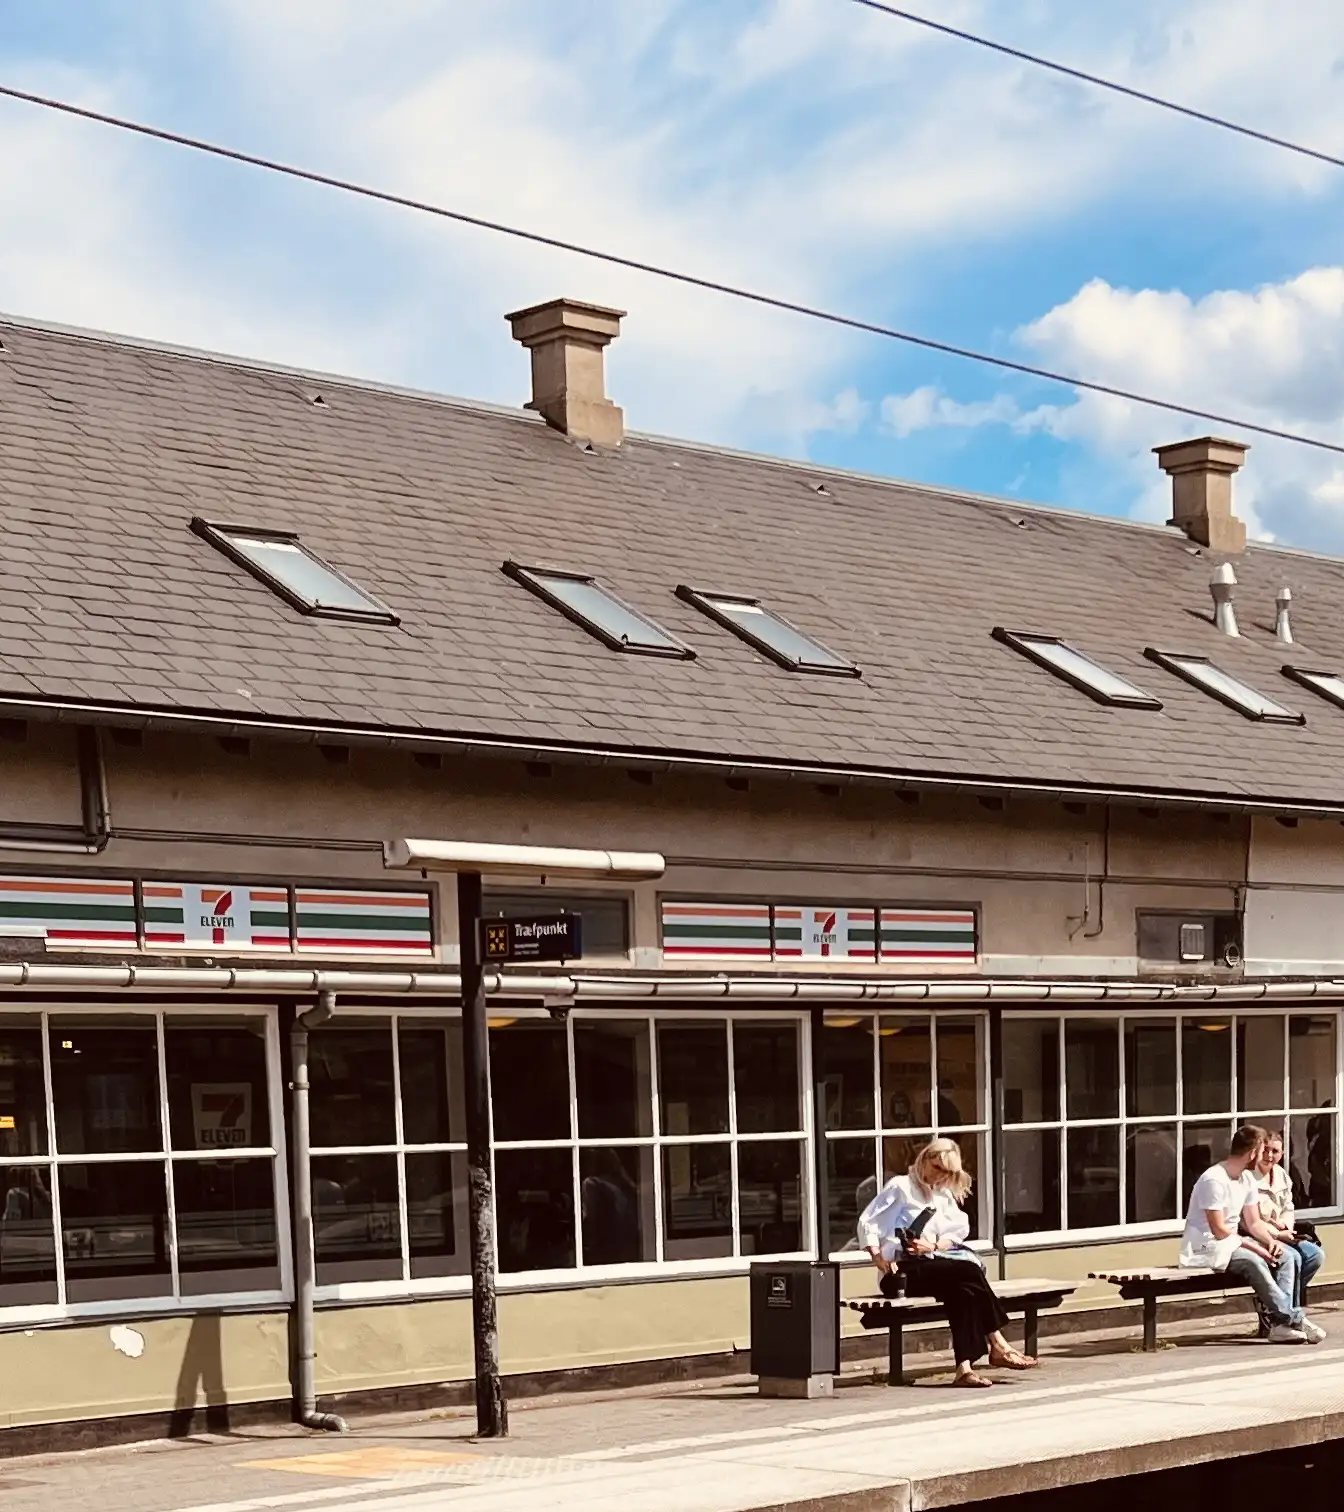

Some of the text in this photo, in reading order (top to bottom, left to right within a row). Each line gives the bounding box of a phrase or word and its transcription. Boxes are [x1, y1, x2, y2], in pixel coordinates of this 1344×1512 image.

[201, 889, 232, 944] 7
[515, 922, 568, 939] Træfpunkt
[814, 912, 836, 957] 7
